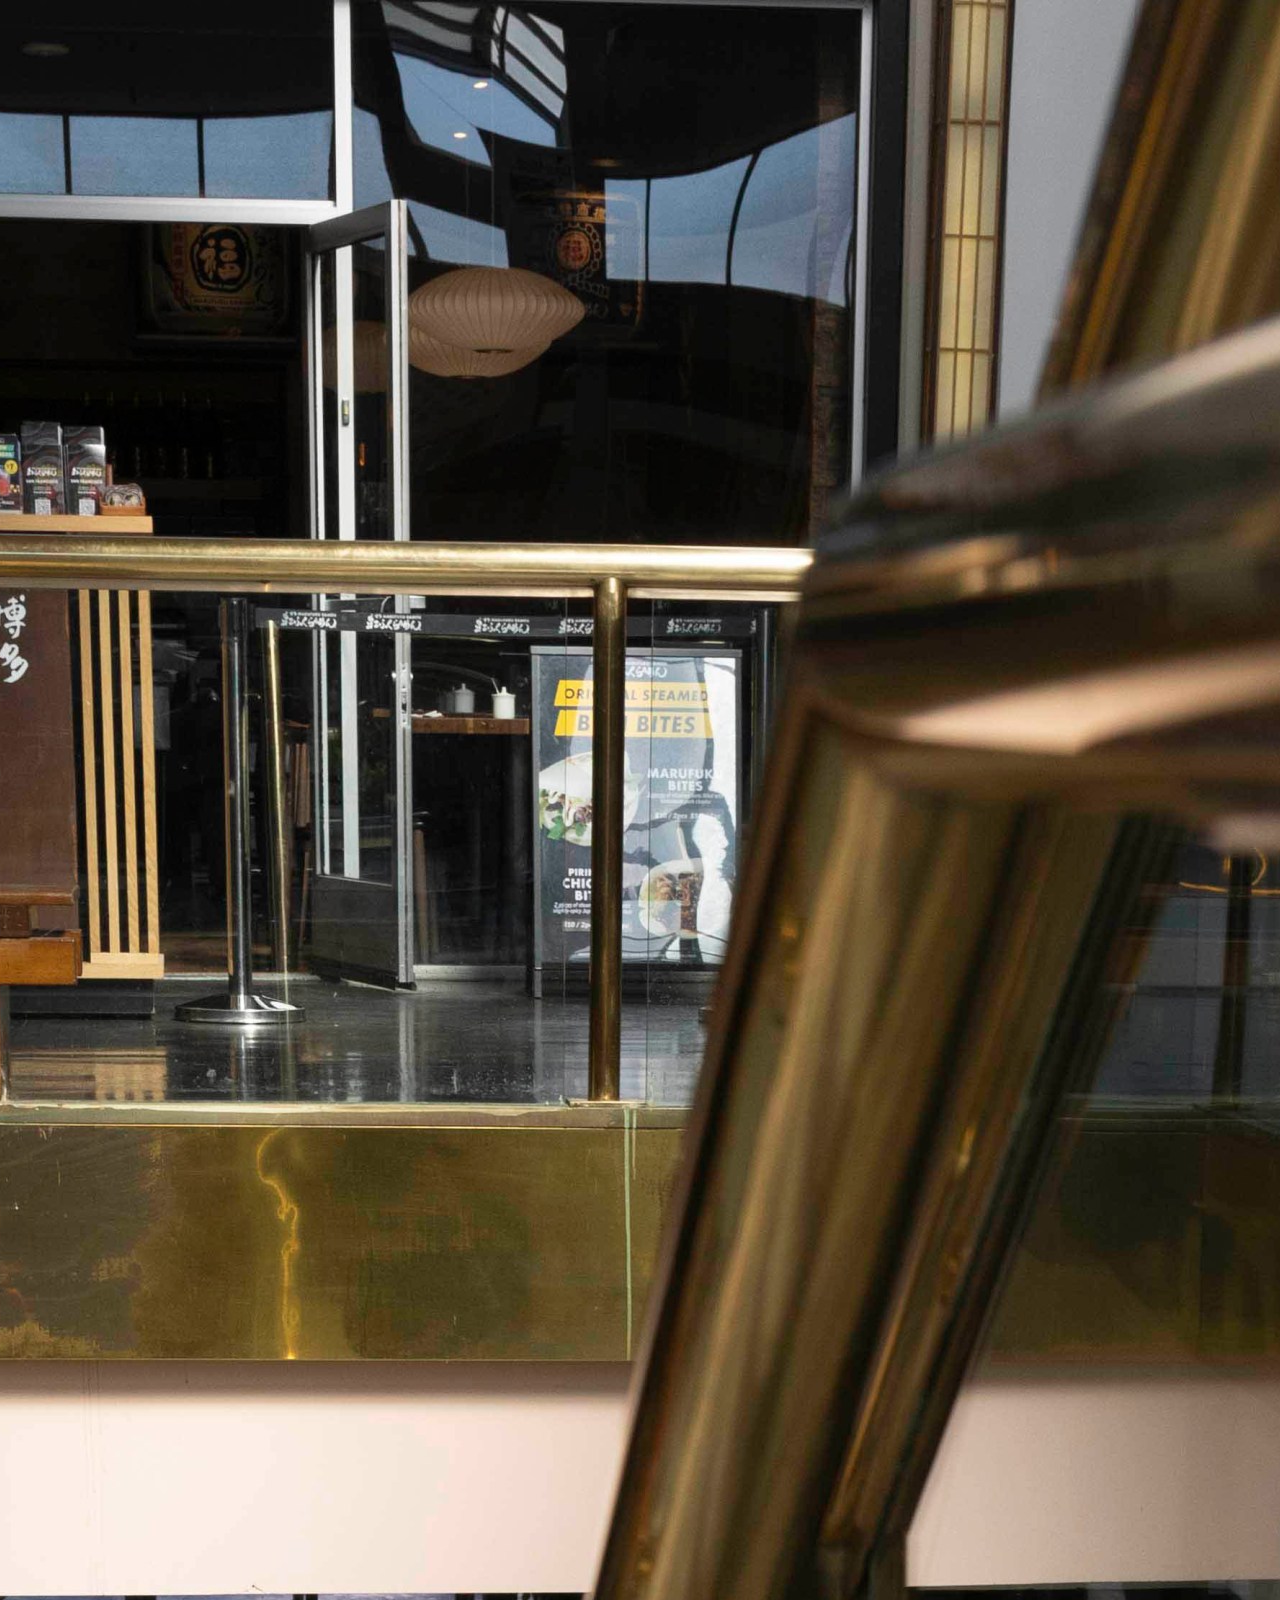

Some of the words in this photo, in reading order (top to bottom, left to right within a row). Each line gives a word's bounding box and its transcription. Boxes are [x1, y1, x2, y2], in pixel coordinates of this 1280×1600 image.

[564, 688, 635, 701] ORIAL
[642, 689, 708, 702] STEAMED
[636, 715, 696, 733] BITES
[647, 768, 721, 779] MARUFUK
[668, 780, 703, 792] BITES
